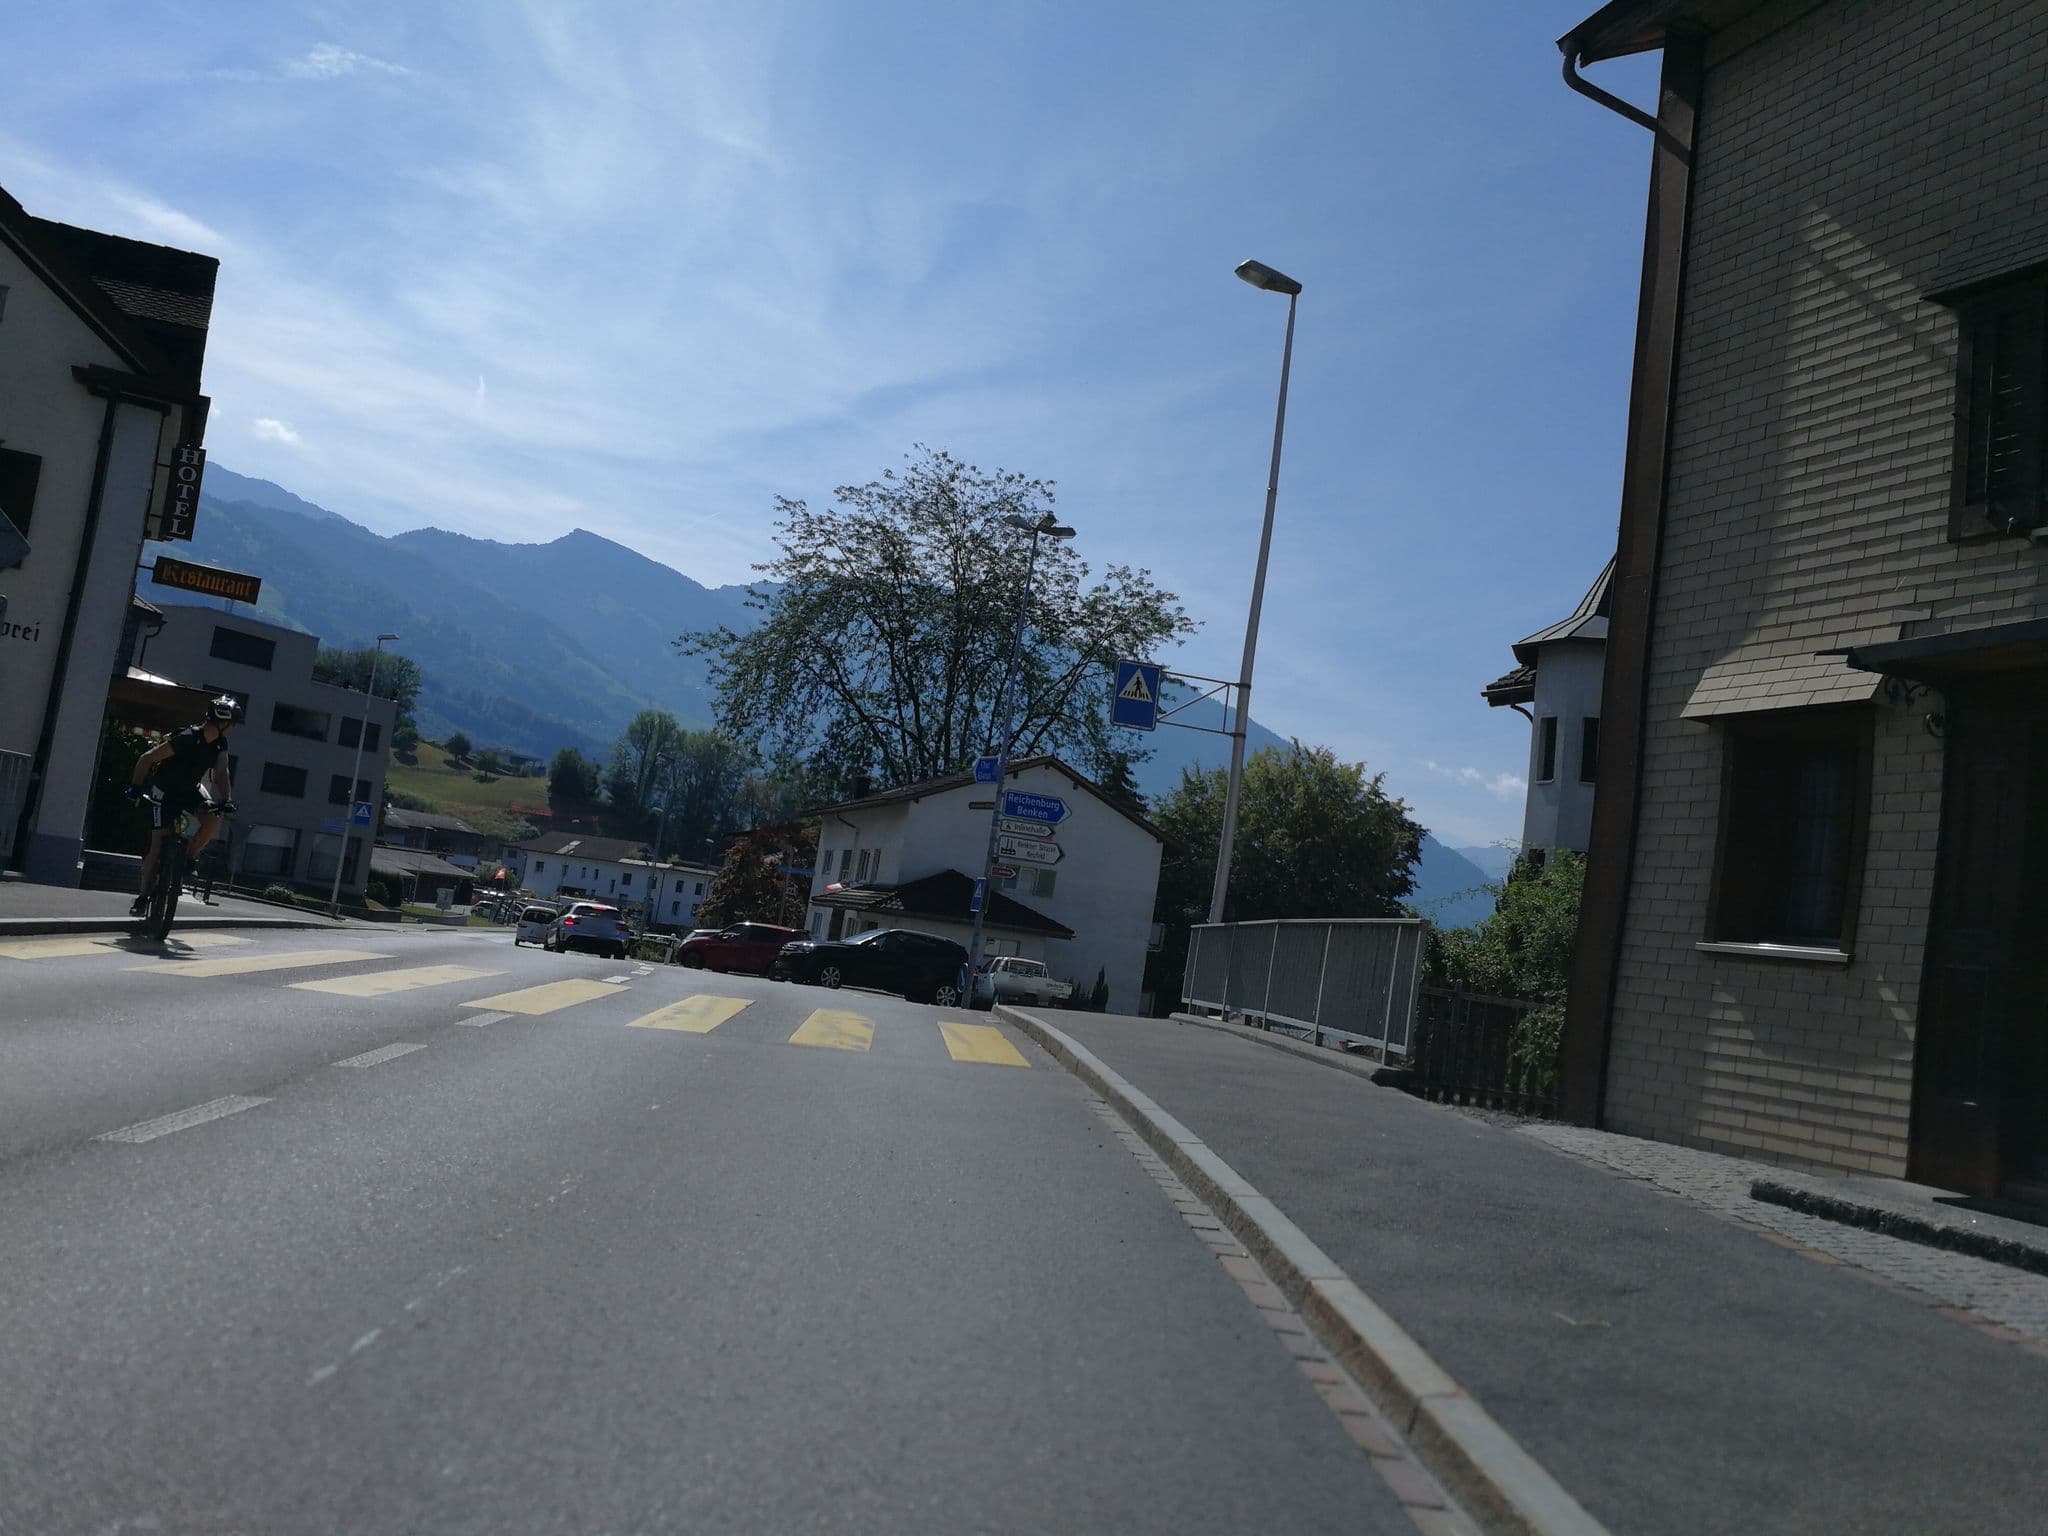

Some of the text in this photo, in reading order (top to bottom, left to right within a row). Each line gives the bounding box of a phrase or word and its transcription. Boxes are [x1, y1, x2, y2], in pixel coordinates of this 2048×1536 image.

[170, 448, 201, 536] HOTEL
[1008, 792, 1060, 812] Reichenburg
[1017, 805, 1049, 819] Benken
